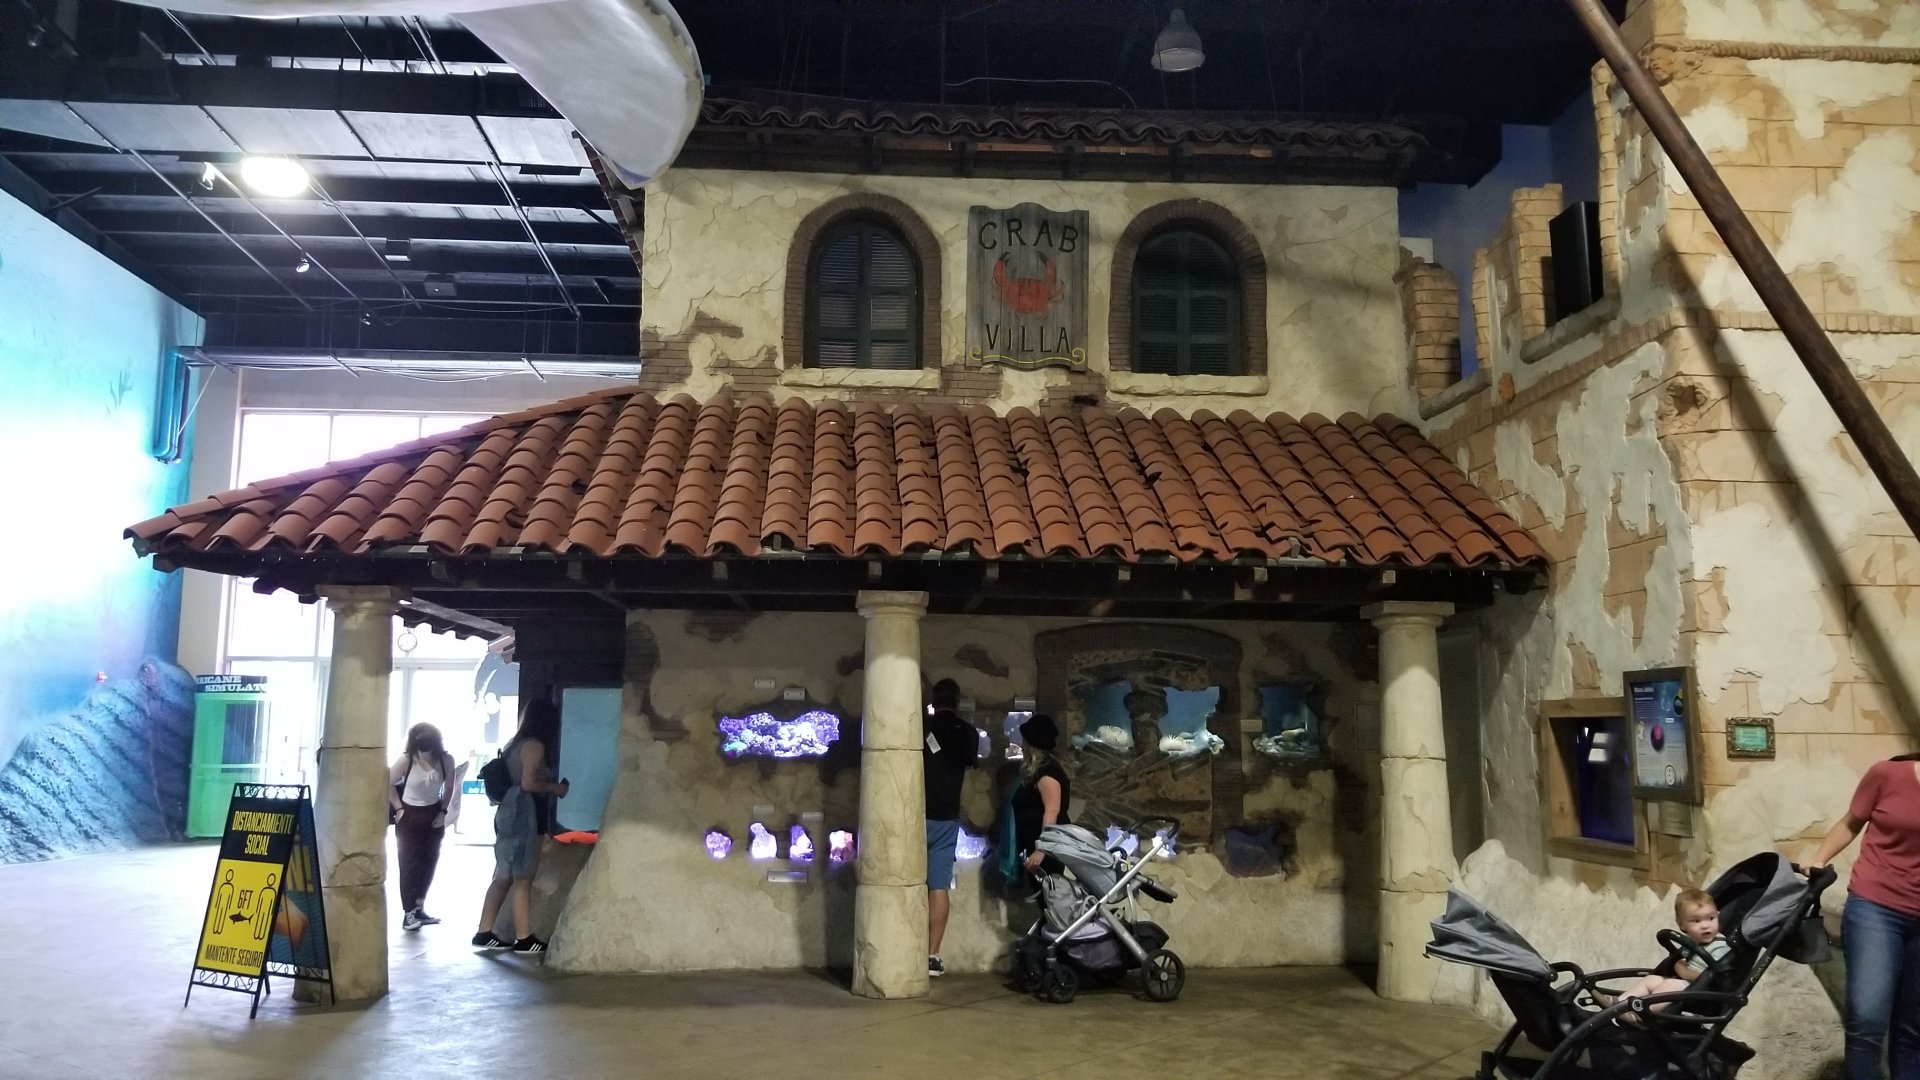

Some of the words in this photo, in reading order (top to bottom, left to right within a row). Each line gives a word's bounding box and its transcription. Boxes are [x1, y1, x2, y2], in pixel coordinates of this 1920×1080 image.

[979, 218, 1078, 253] CRAB
[985, 323, 1071, 354] VILLA
[244, 833, 270, 855] SOCIAL
[237, 889, 254, 910] 6FT
[205, 944, 238, 965] MANTENTE
[237, 948, 263, 968] SEGURO
